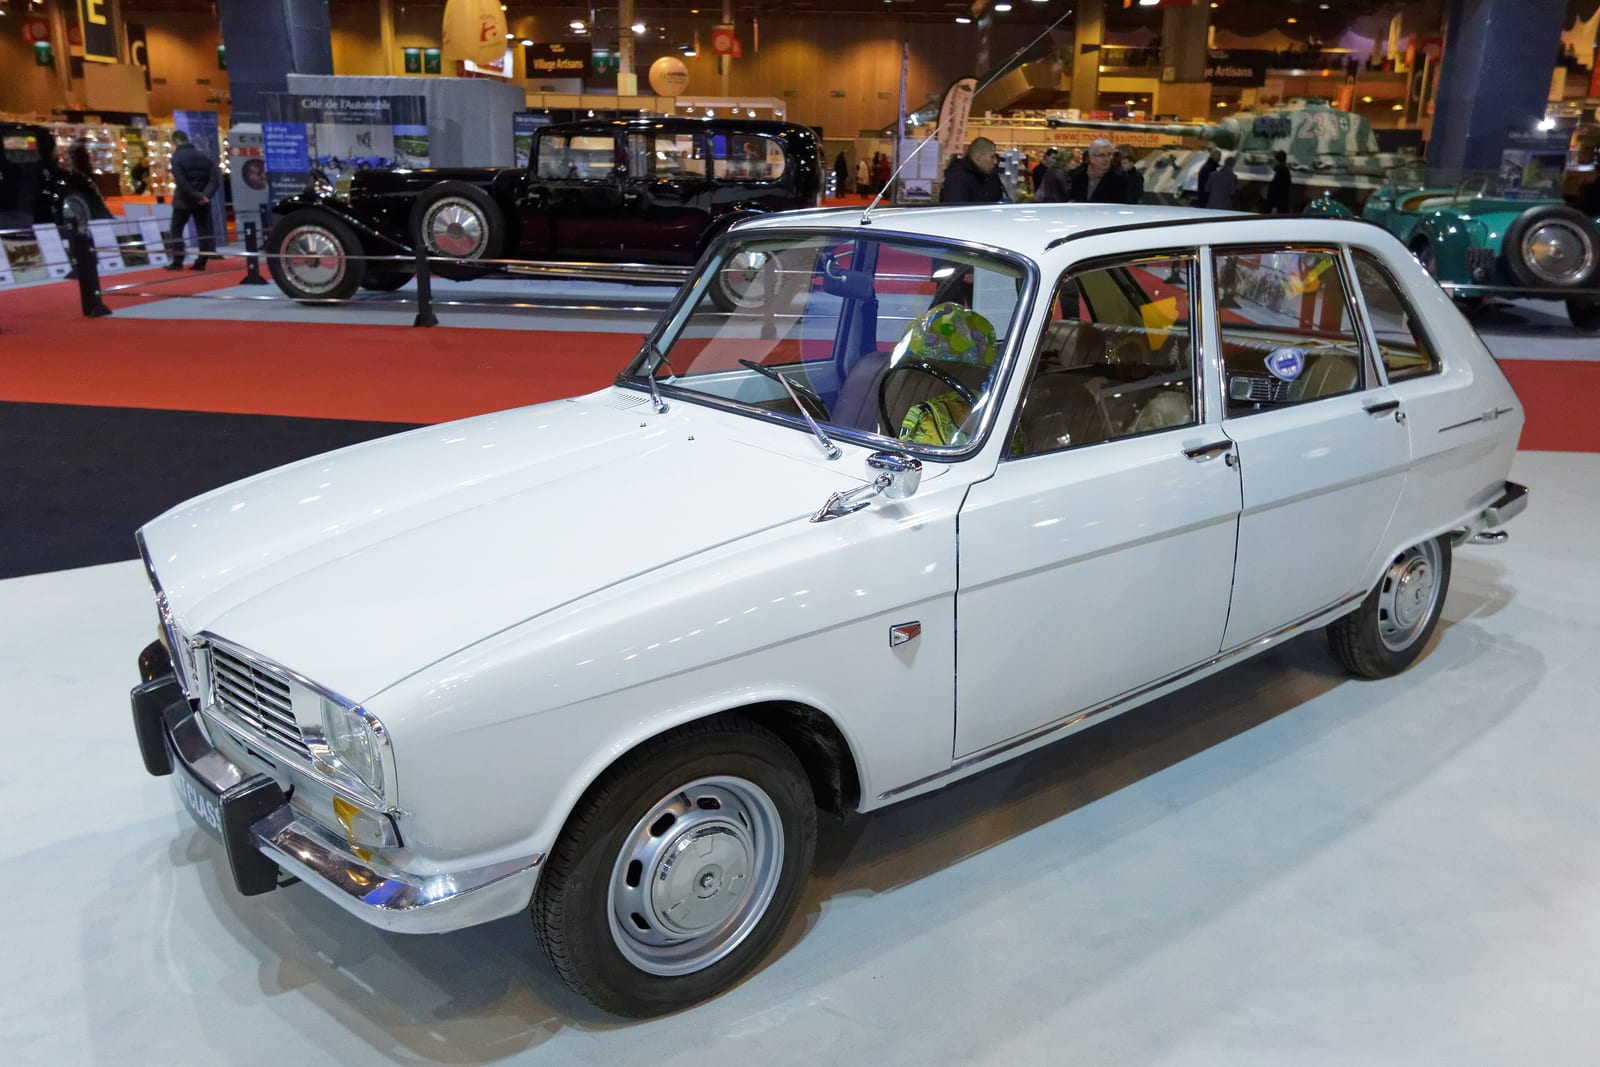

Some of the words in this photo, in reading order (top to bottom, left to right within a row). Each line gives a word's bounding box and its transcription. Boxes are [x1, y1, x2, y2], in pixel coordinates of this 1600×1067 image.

[533, 58, 555, 72] Village
[557, 58, 583, 69] Artisans
[1214, 66, 1253, 77] Artisans
[301, 98, 322, 109] Cité
[325, 98, 338, 109] de
